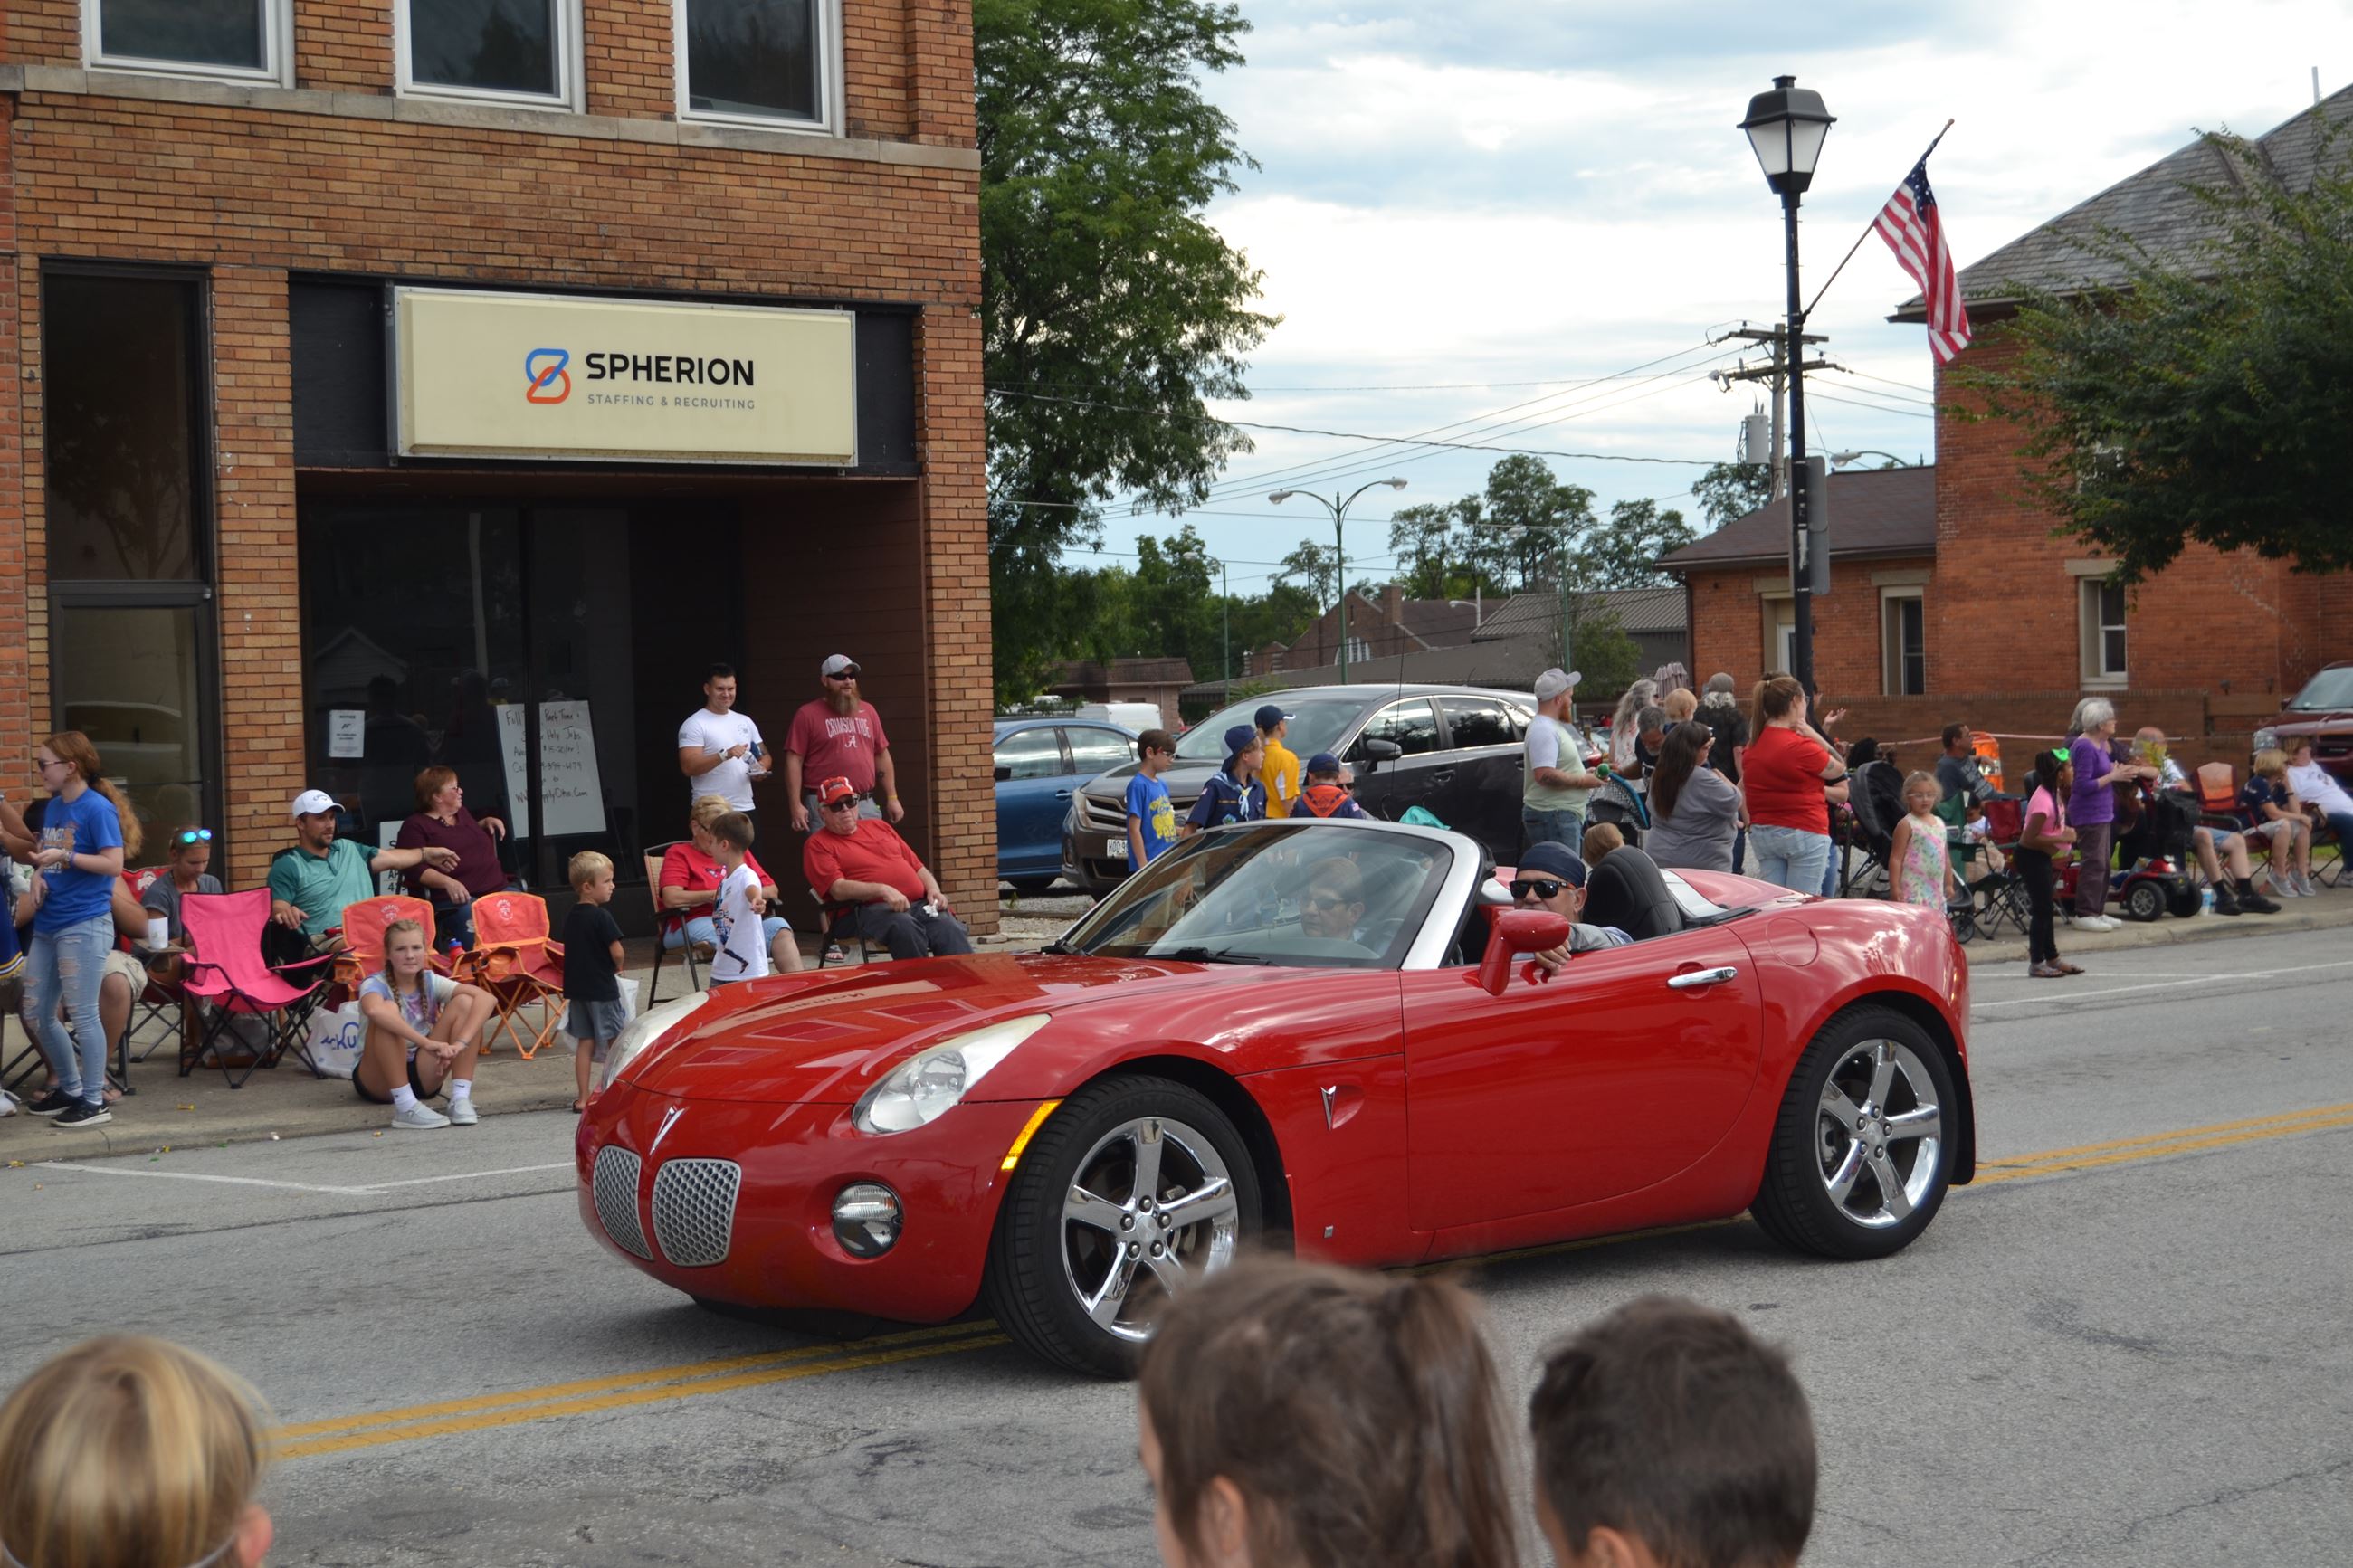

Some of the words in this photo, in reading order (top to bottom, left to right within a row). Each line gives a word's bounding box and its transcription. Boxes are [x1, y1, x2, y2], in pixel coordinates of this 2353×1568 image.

[586, 352, 754, 386] SPHERION
[587, 394, 655, 406] STAFFING
[661, 396, 668, 407] &
[674, 396, 755, 410] RECRUITING
[825, 716, 856, 738] CRIMSON
[855, 717, 872, 738] TIDE
